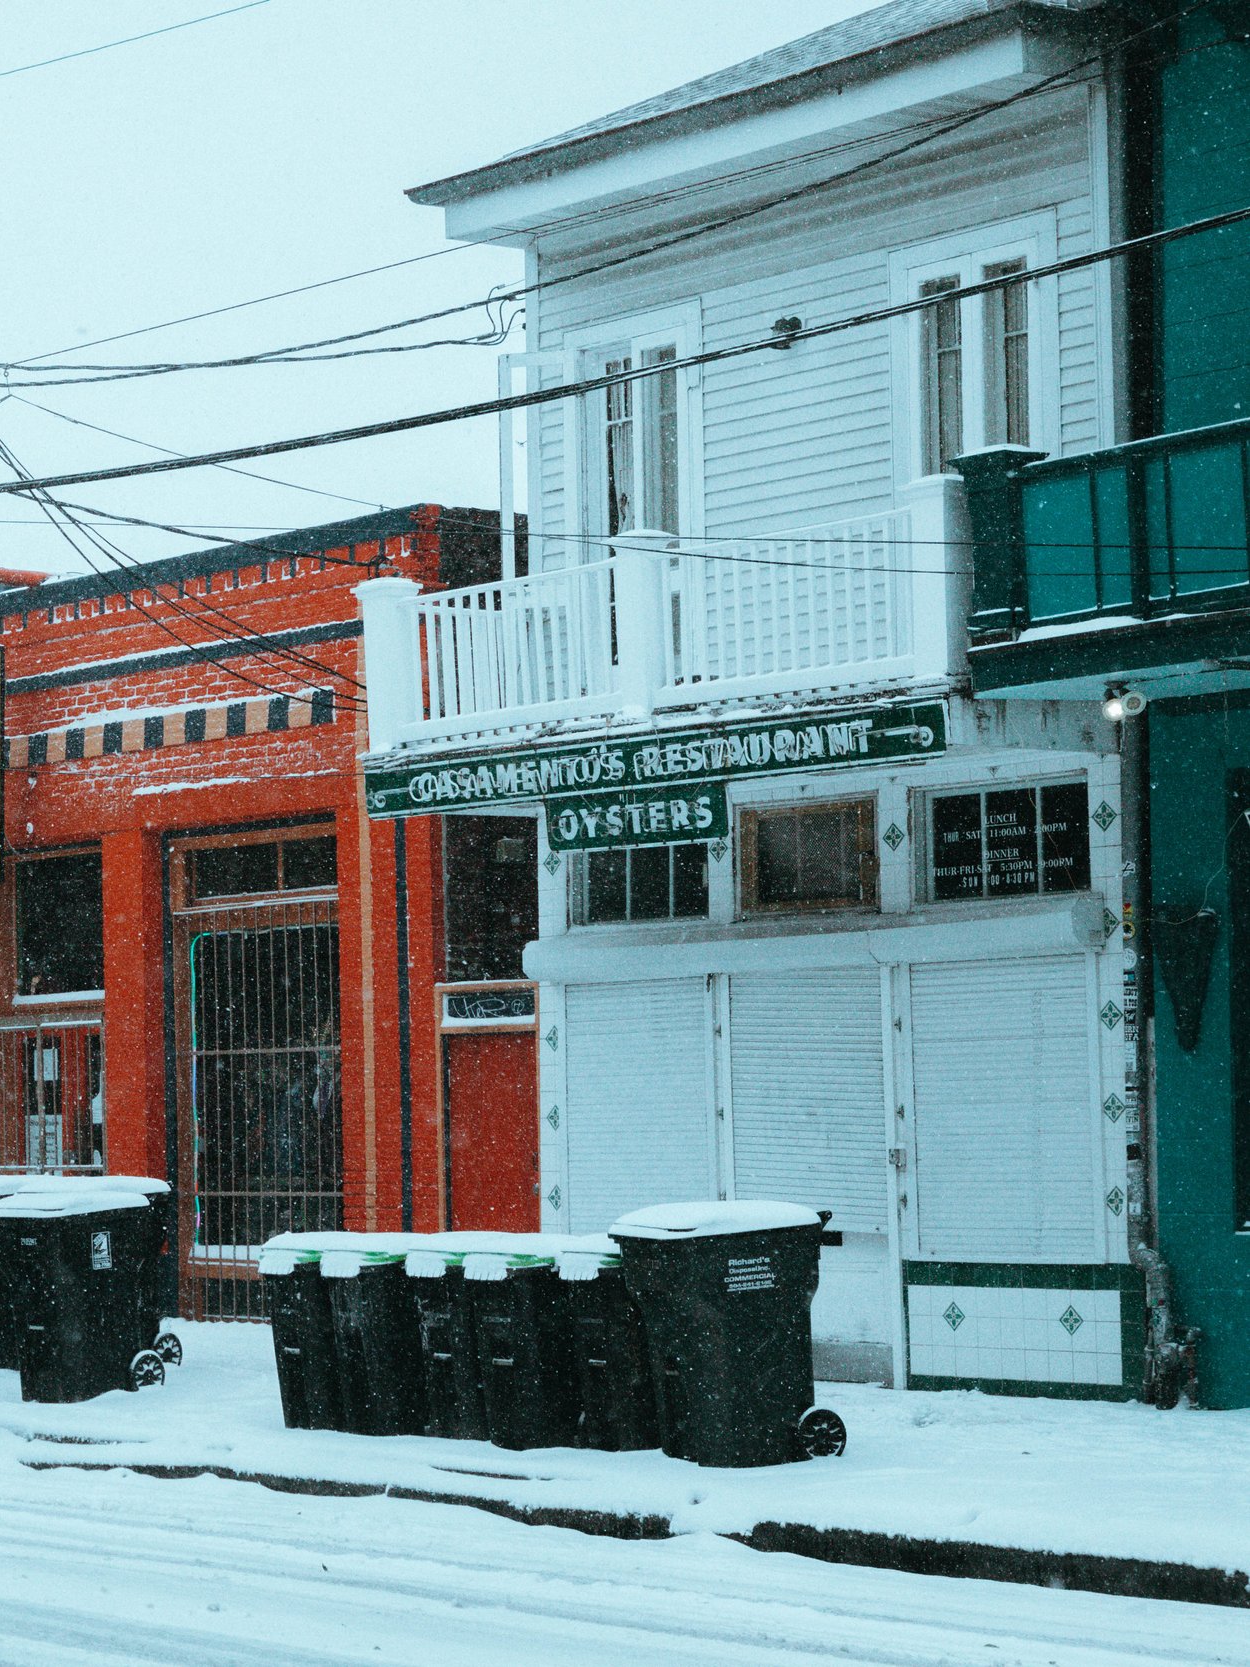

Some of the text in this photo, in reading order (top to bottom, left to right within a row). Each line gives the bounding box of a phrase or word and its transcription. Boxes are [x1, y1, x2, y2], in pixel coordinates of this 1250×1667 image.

[635, 719, 874, 779] RESTAURANT
[553, 796, 714, 842] OYSTERS
[983, 813, 1017, 826] LUNCH
[943, 822, 1067, 843] THUR SAT 11:00AM 200PM
[984, 848, 1020, 859] DINNER
[1000, 860, 1033, 872] 5:30PM
[961, 876, 978, 888] SUN
[1024, 871, 1035, 883] PM
[728, 1257, 770, 1266] Richard's
[724, 1273, 774, 1282] COMMERCIAL
